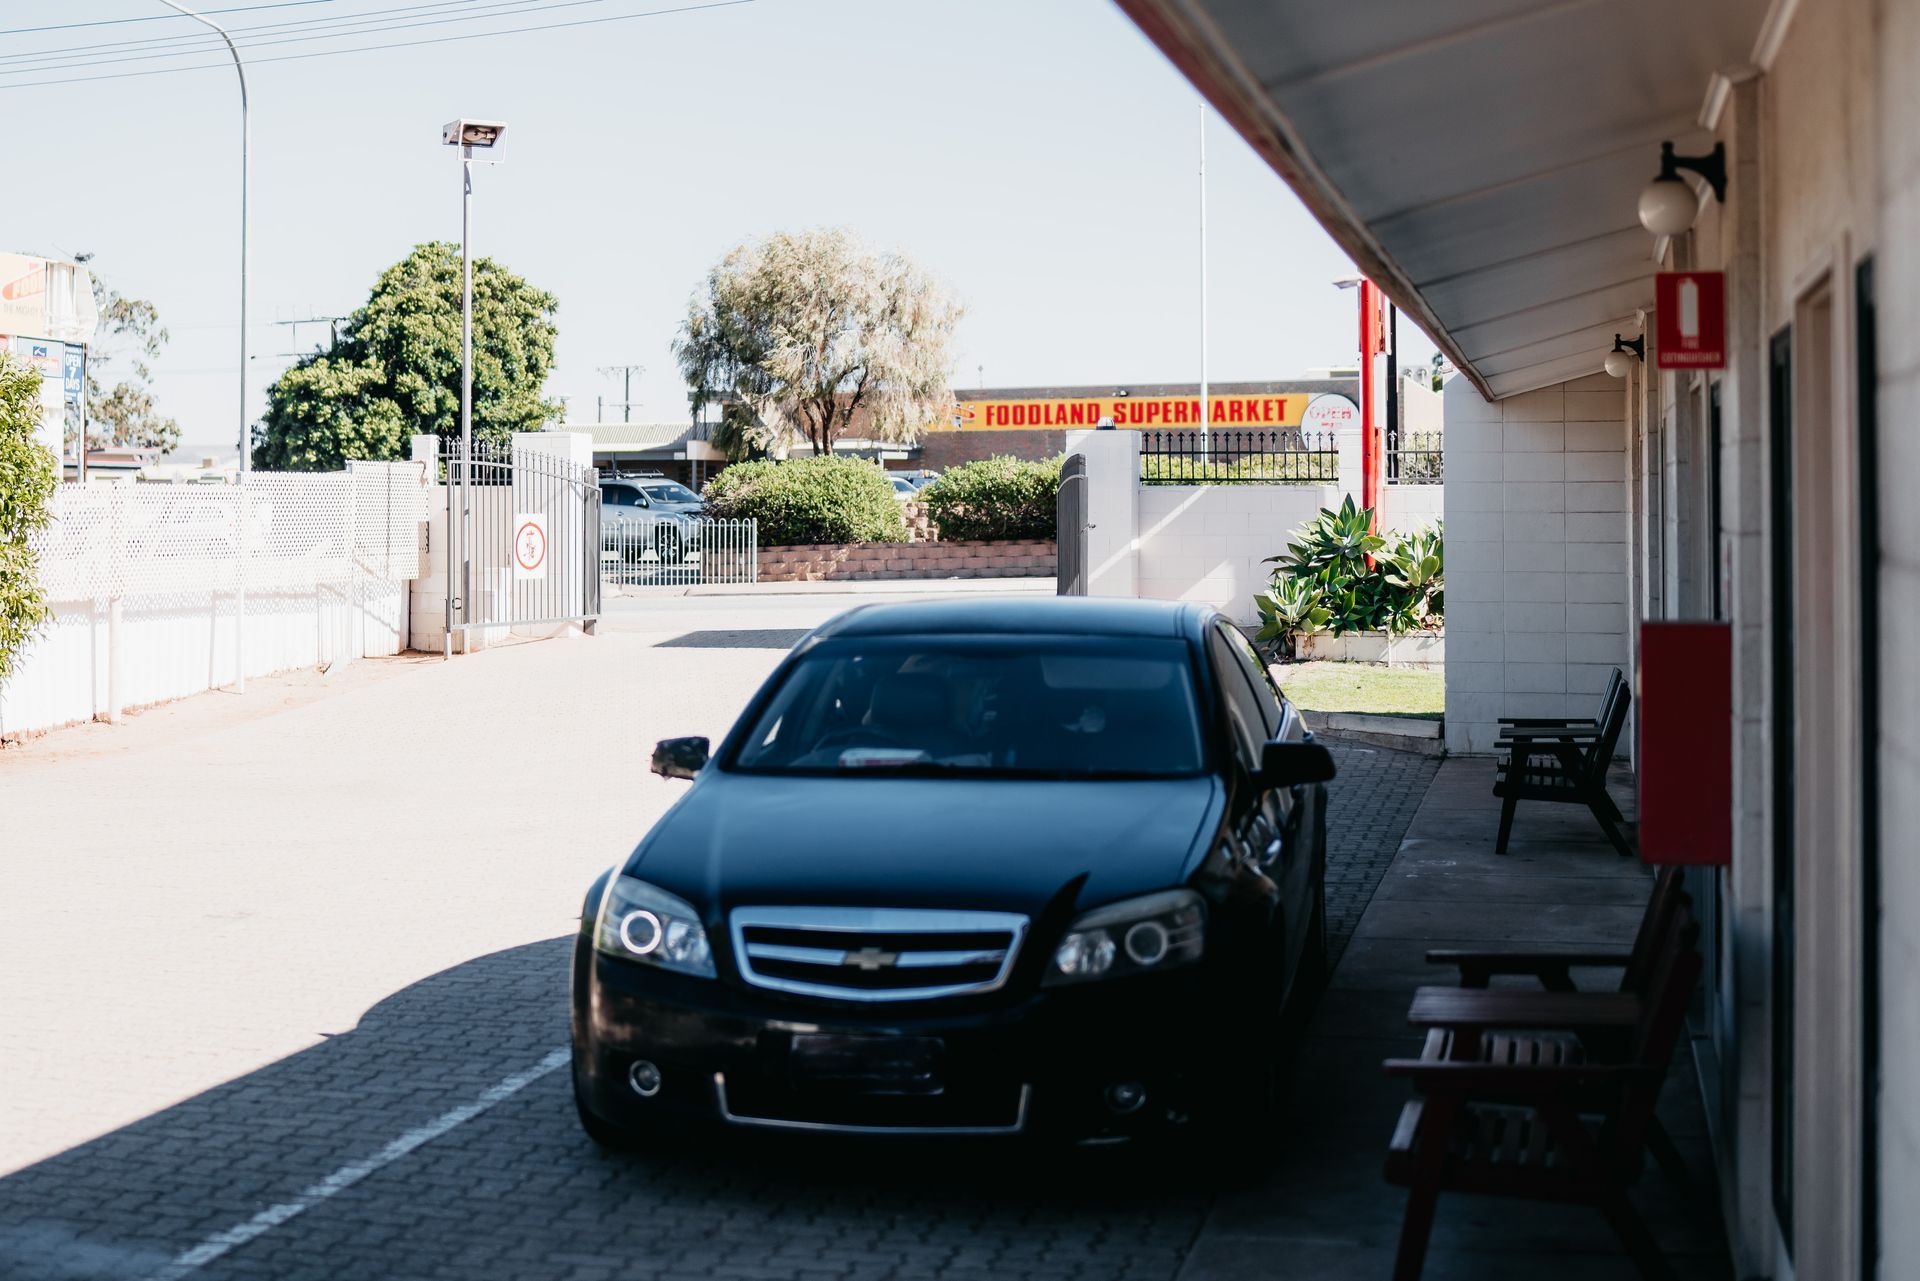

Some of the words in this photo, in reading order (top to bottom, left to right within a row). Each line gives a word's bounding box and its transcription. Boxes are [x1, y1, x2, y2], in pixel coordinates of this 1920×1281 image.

[65, 353, 82, 368] OPEN
[69, 366, 77, 379] 7
[65, 376, 81, 391] DAYS
[985, 403, 1101, 426] FOODLAND
[1112, 399, 1288, 425] SUPERMARKET
